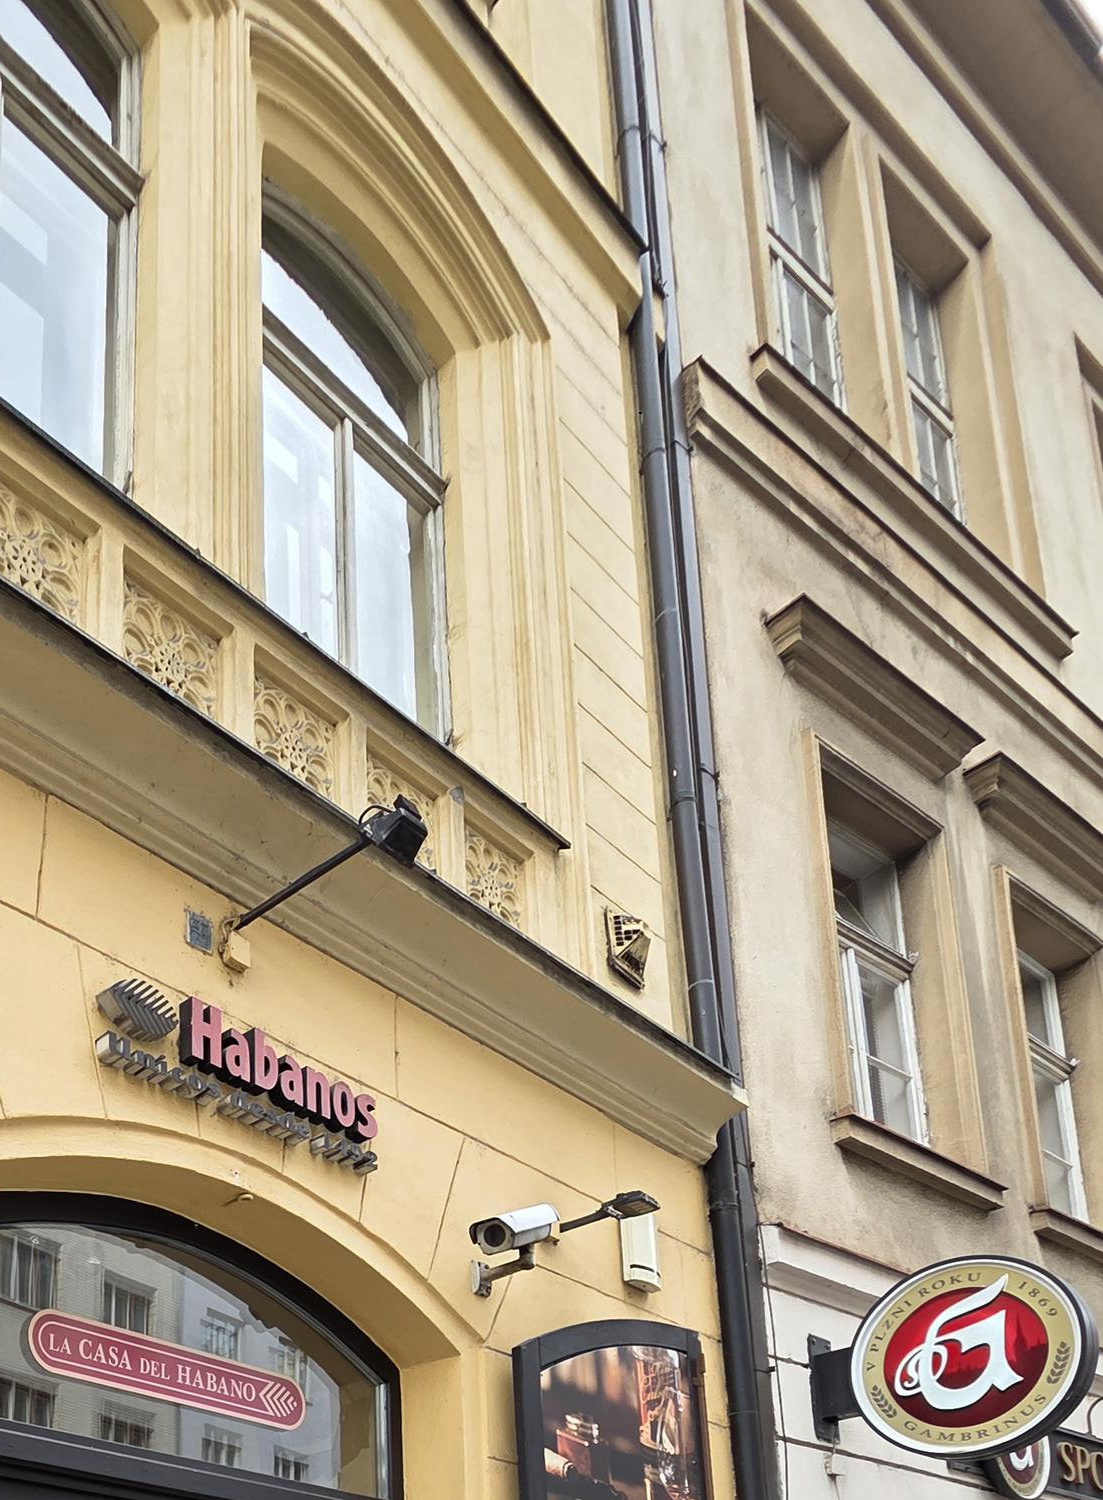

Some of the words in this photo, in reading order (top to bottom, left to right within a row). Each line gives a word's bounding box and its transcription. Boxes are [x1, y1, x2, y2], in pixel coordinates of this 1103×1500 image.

[182, 996, 379, 1141] Habanos
[917, 1272, 982, 1299] ROKU
[1017, 1281, 1058, 1317] 1869
[870, 1299, 913, 1353] PLZNI
[49, 1333, 72, 1356] LA
[79, 1339, 133, 1371] CASA
[140, 1358, 171, 1380] DEL
[177, 1364, 257, 1401] HABANO
[866, 1361, 877, 1372] V
[903, 1393, 1047, 1443] GAMBRINUS
